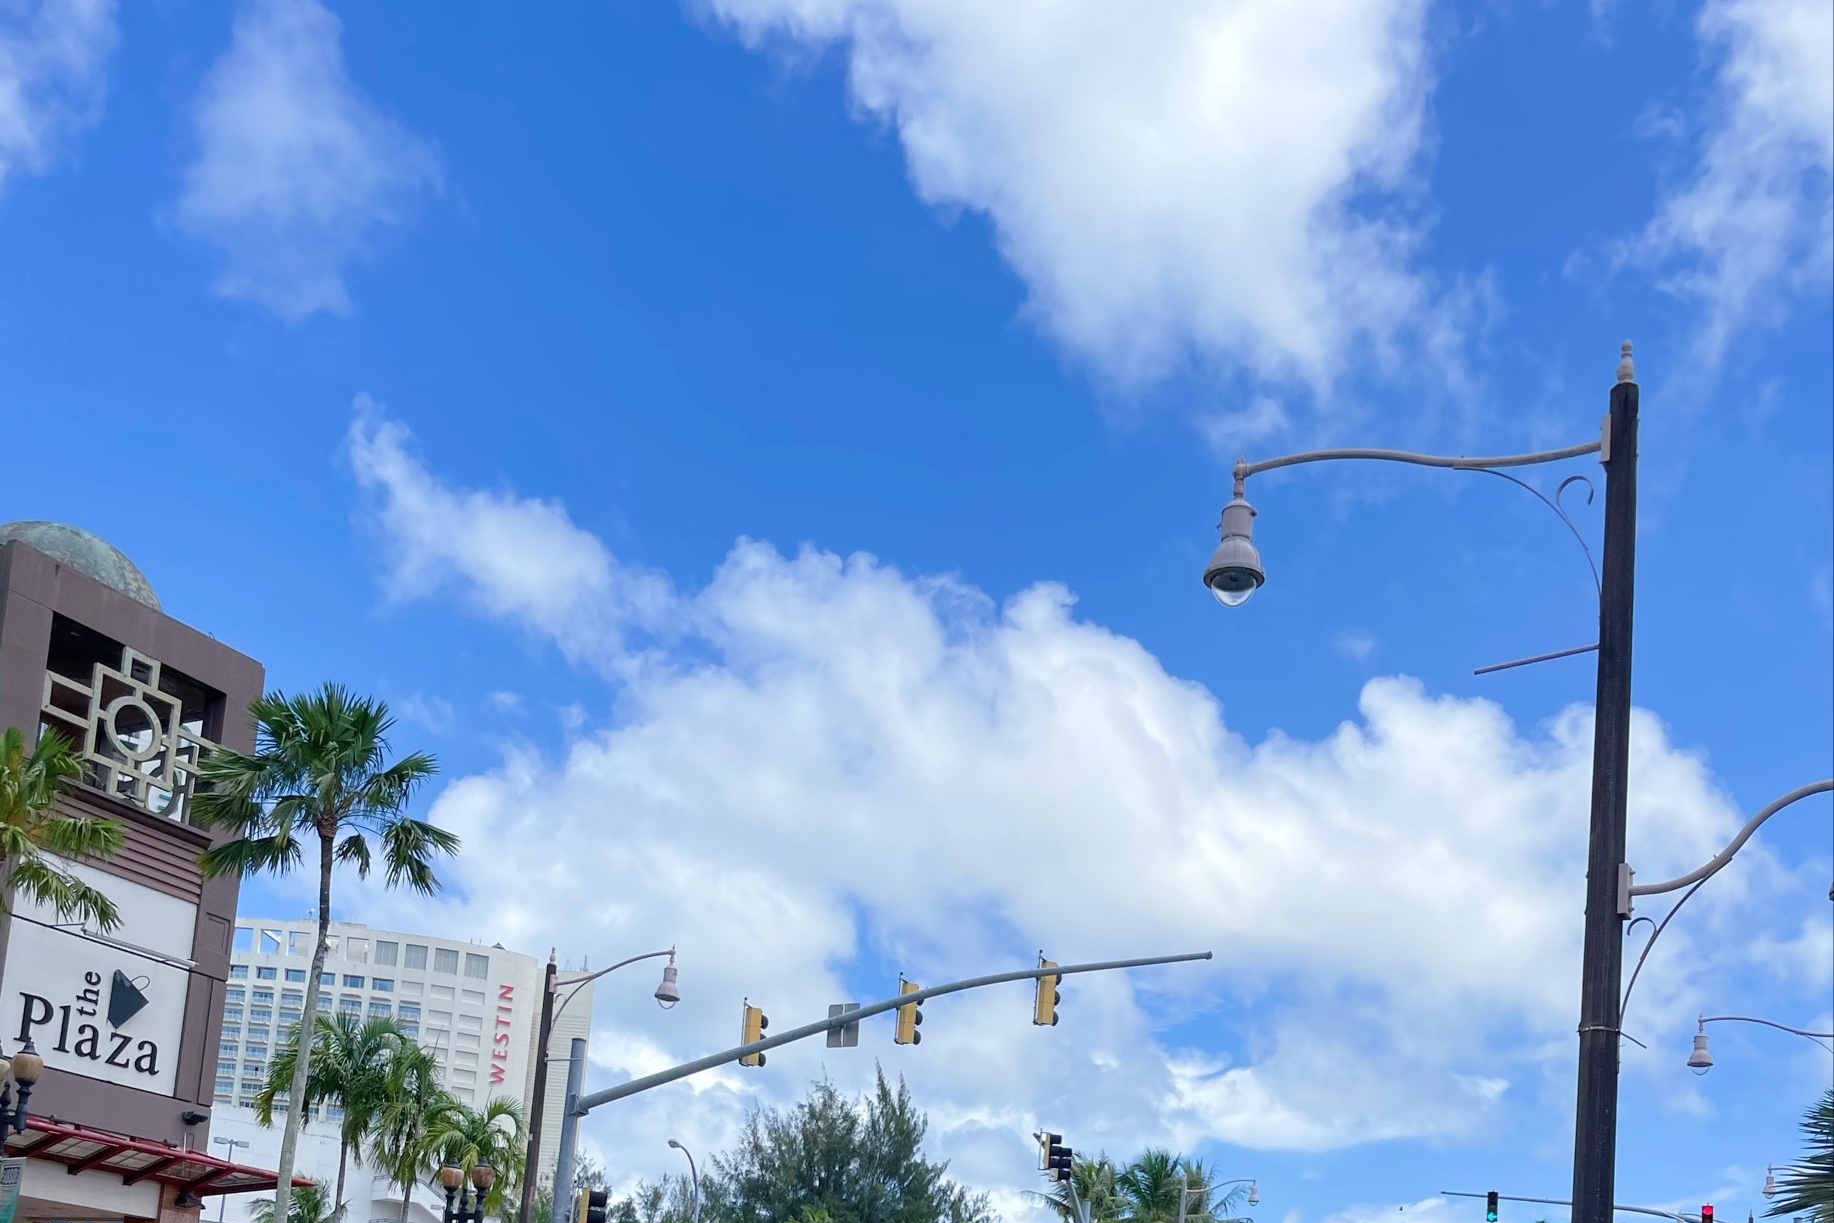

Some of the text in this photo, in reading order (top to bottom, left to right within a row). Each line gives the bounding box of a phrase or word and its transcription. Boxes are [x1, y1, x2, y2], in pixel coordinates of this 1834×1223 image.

[13, 991, 160, 1076] Plaza
[76, 971, 101, 1016] the
[489, 984, 515, 1085] WESTIN
